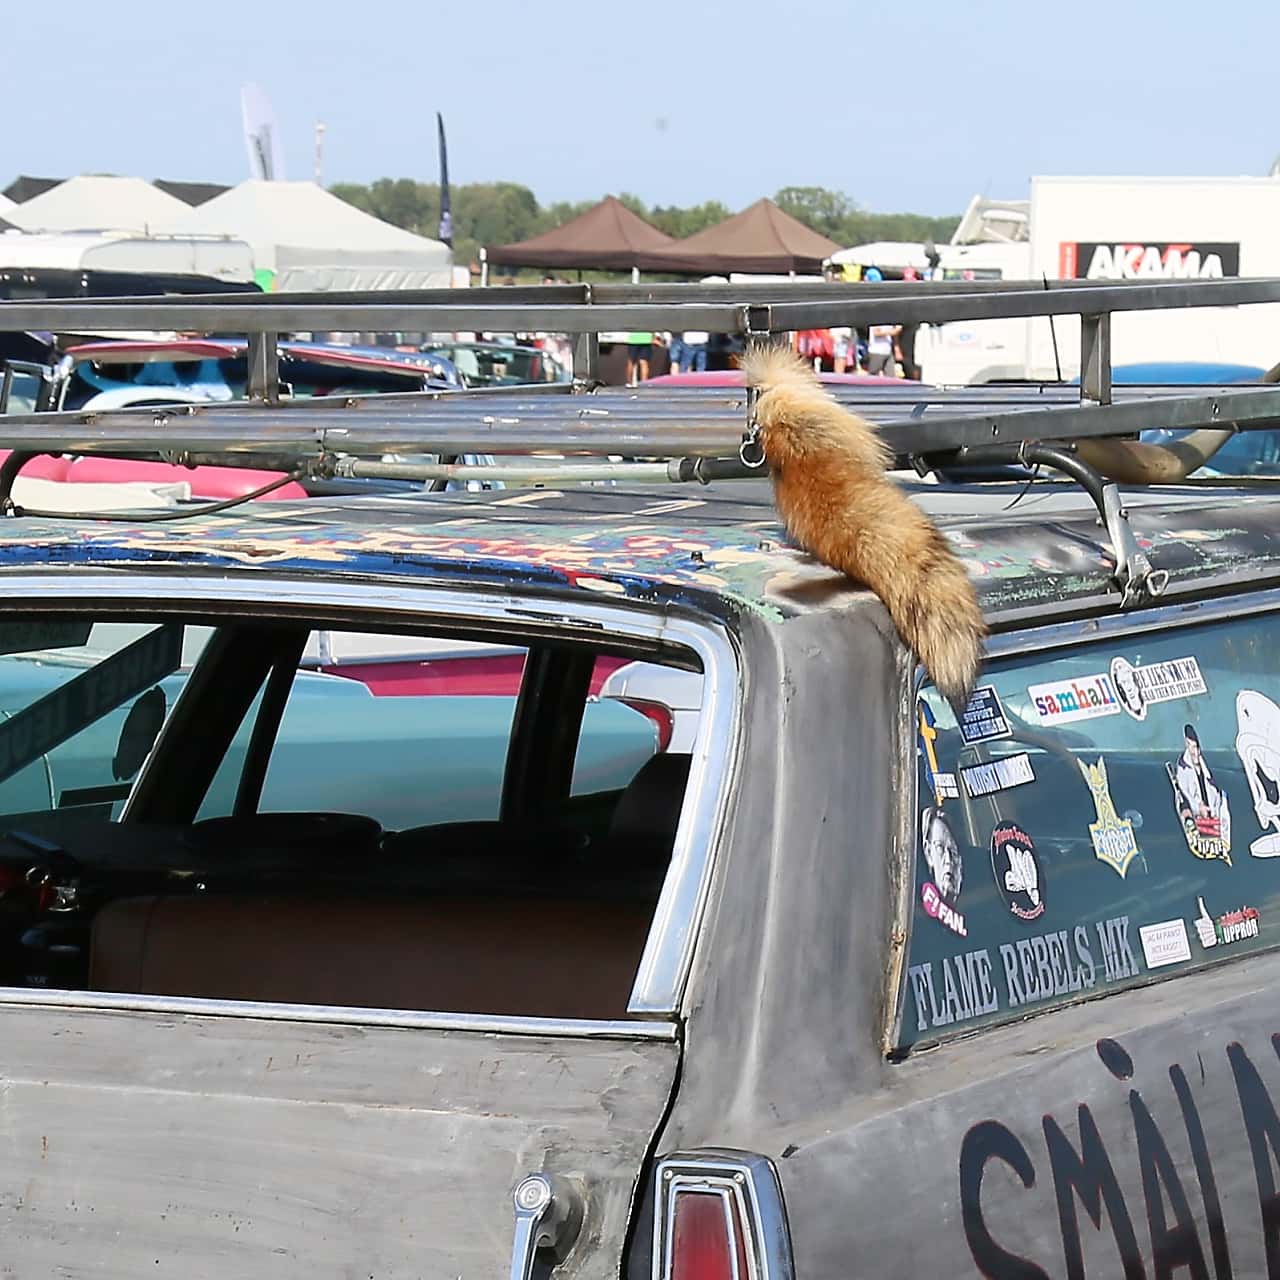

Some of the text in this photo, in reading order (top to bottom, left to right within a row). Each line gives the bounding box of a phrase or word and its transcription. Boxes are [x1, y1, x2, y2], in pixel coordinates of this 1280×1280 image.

[1035, 677, 1115, 717] samhall
[909, 916, 1140, 1031] FLAME REBELS MK
